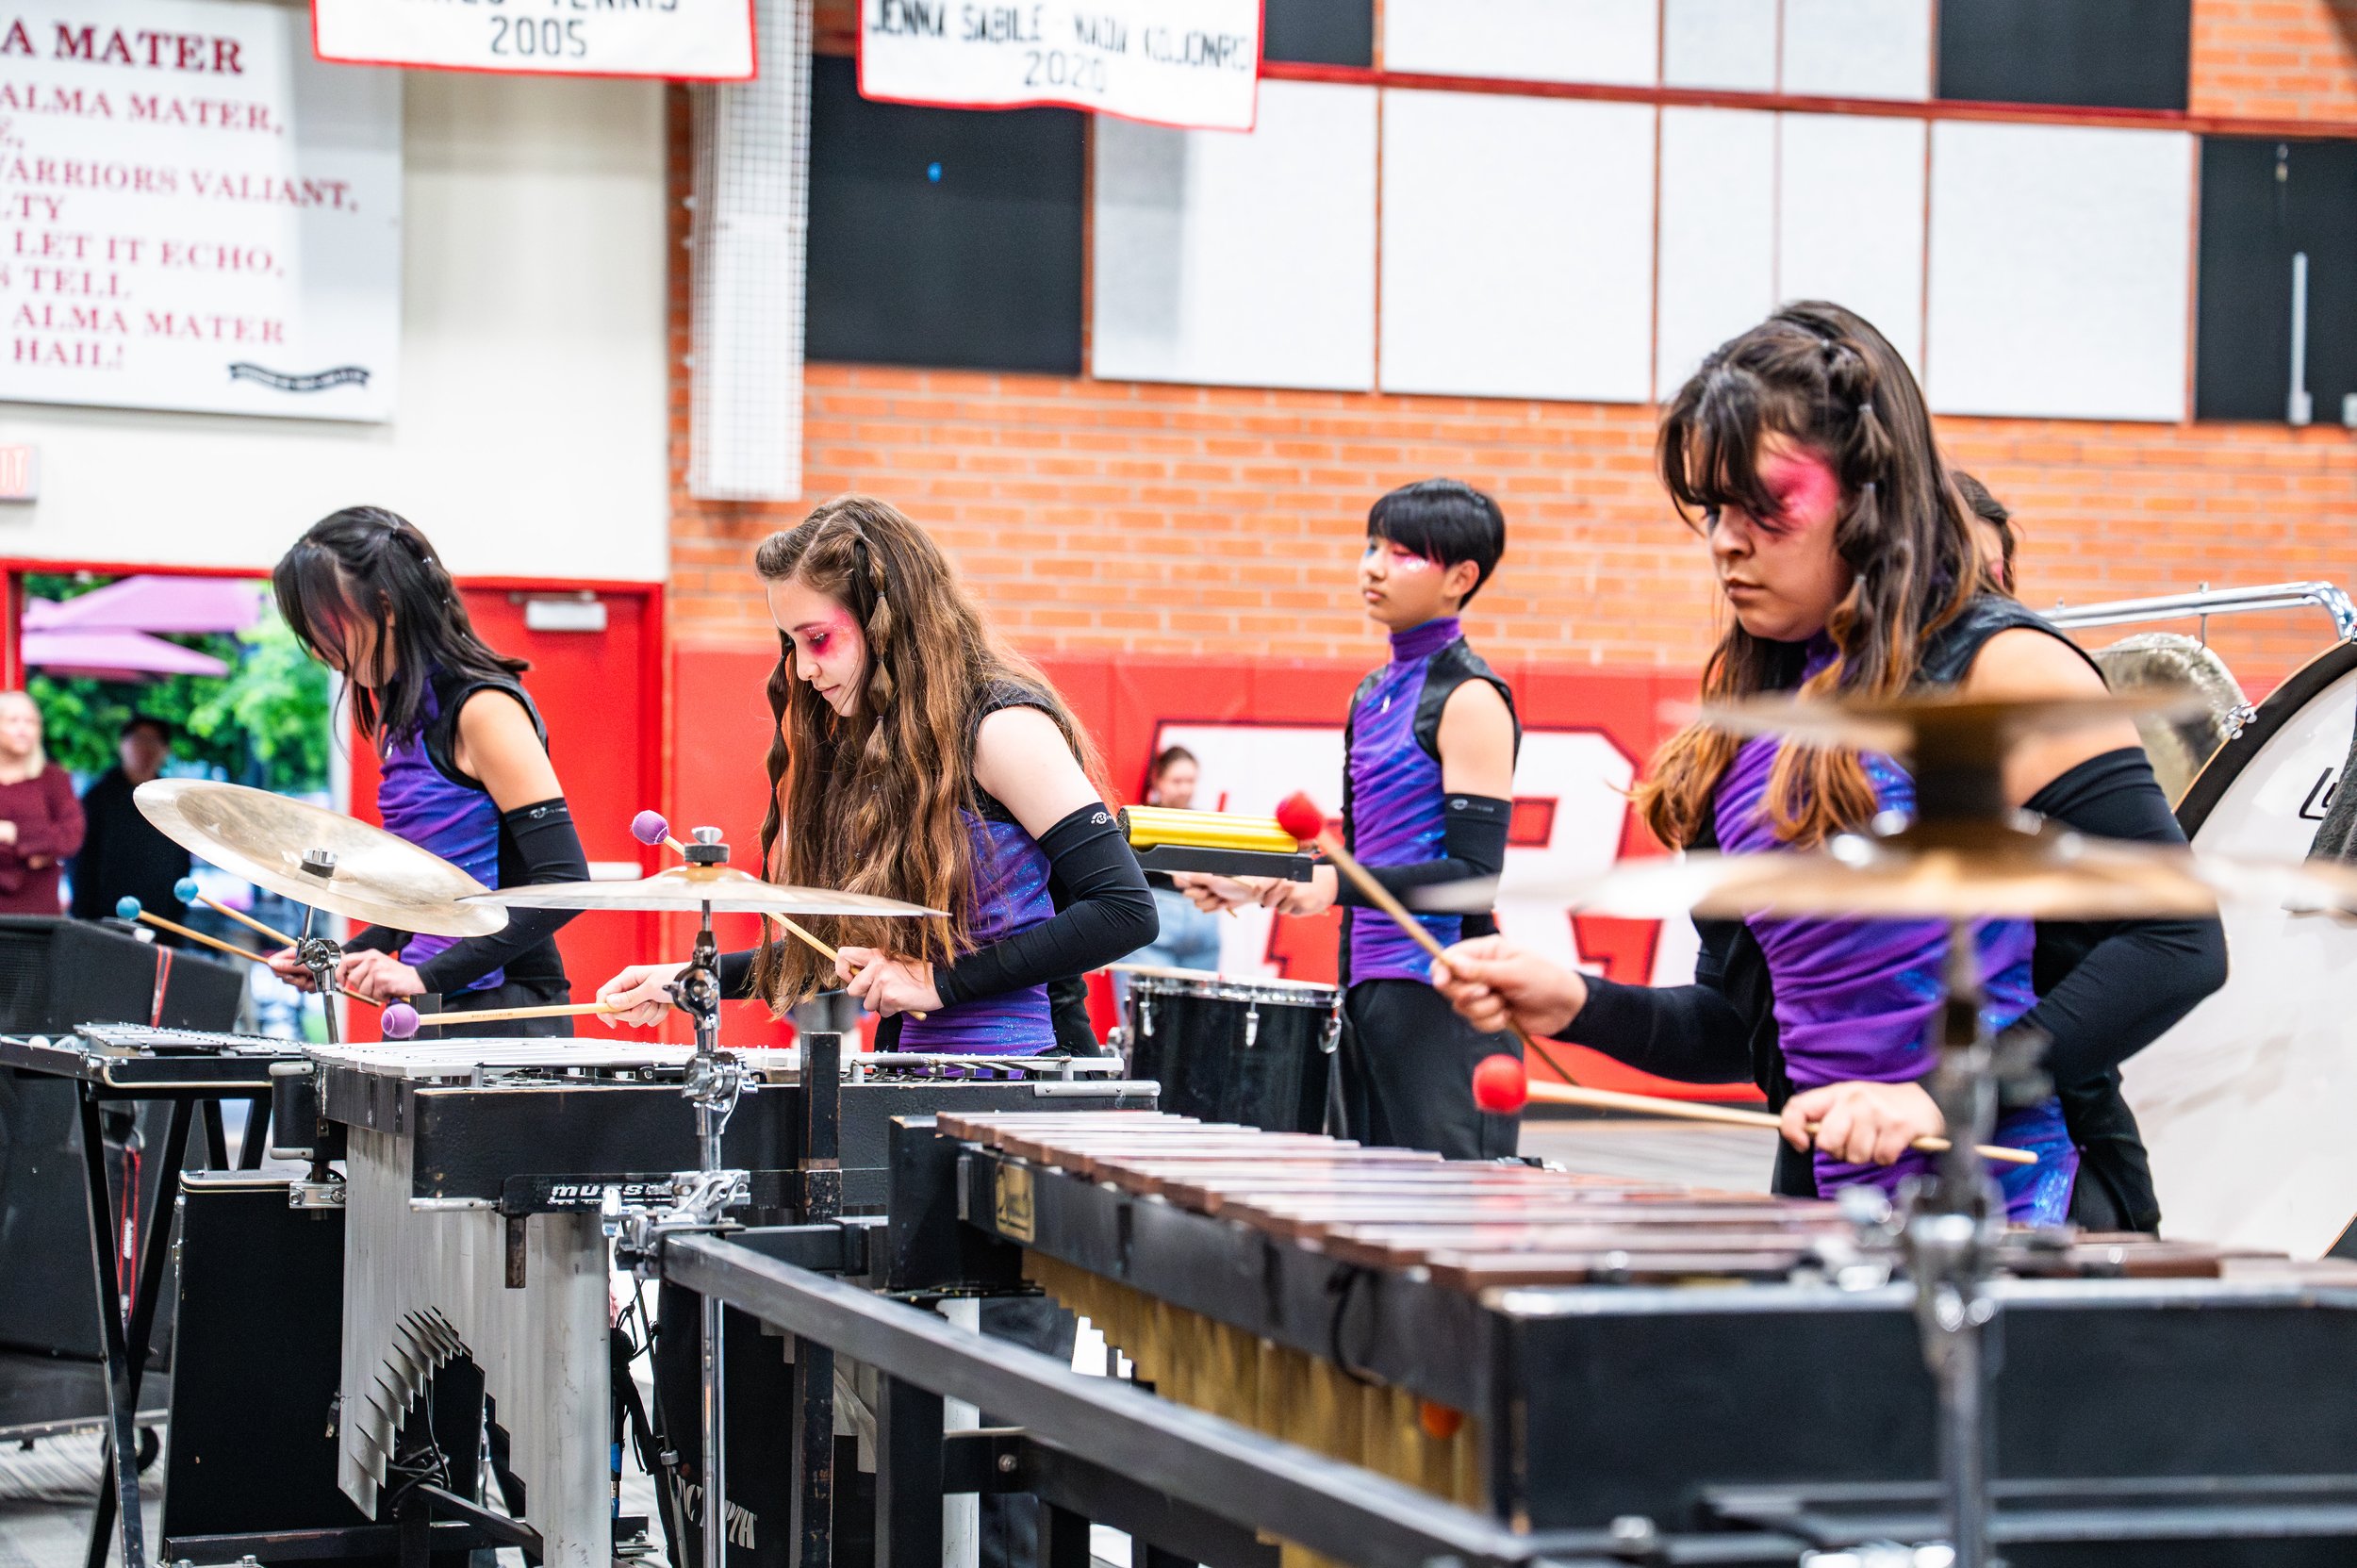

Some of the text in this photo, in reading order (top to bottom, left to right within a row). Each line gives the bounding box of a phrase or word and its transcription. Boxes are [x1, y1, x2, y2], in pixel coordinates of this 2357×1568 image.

[54, 23, 243, 74] MATER
[490, 16, 587, 56] 2005
[0, 82, 113, 119] ALMA
[15, 229, 93, 258] LET
[107, 237, 146, 264] IT
[13, 302, 286, 344] ALMA MATER
